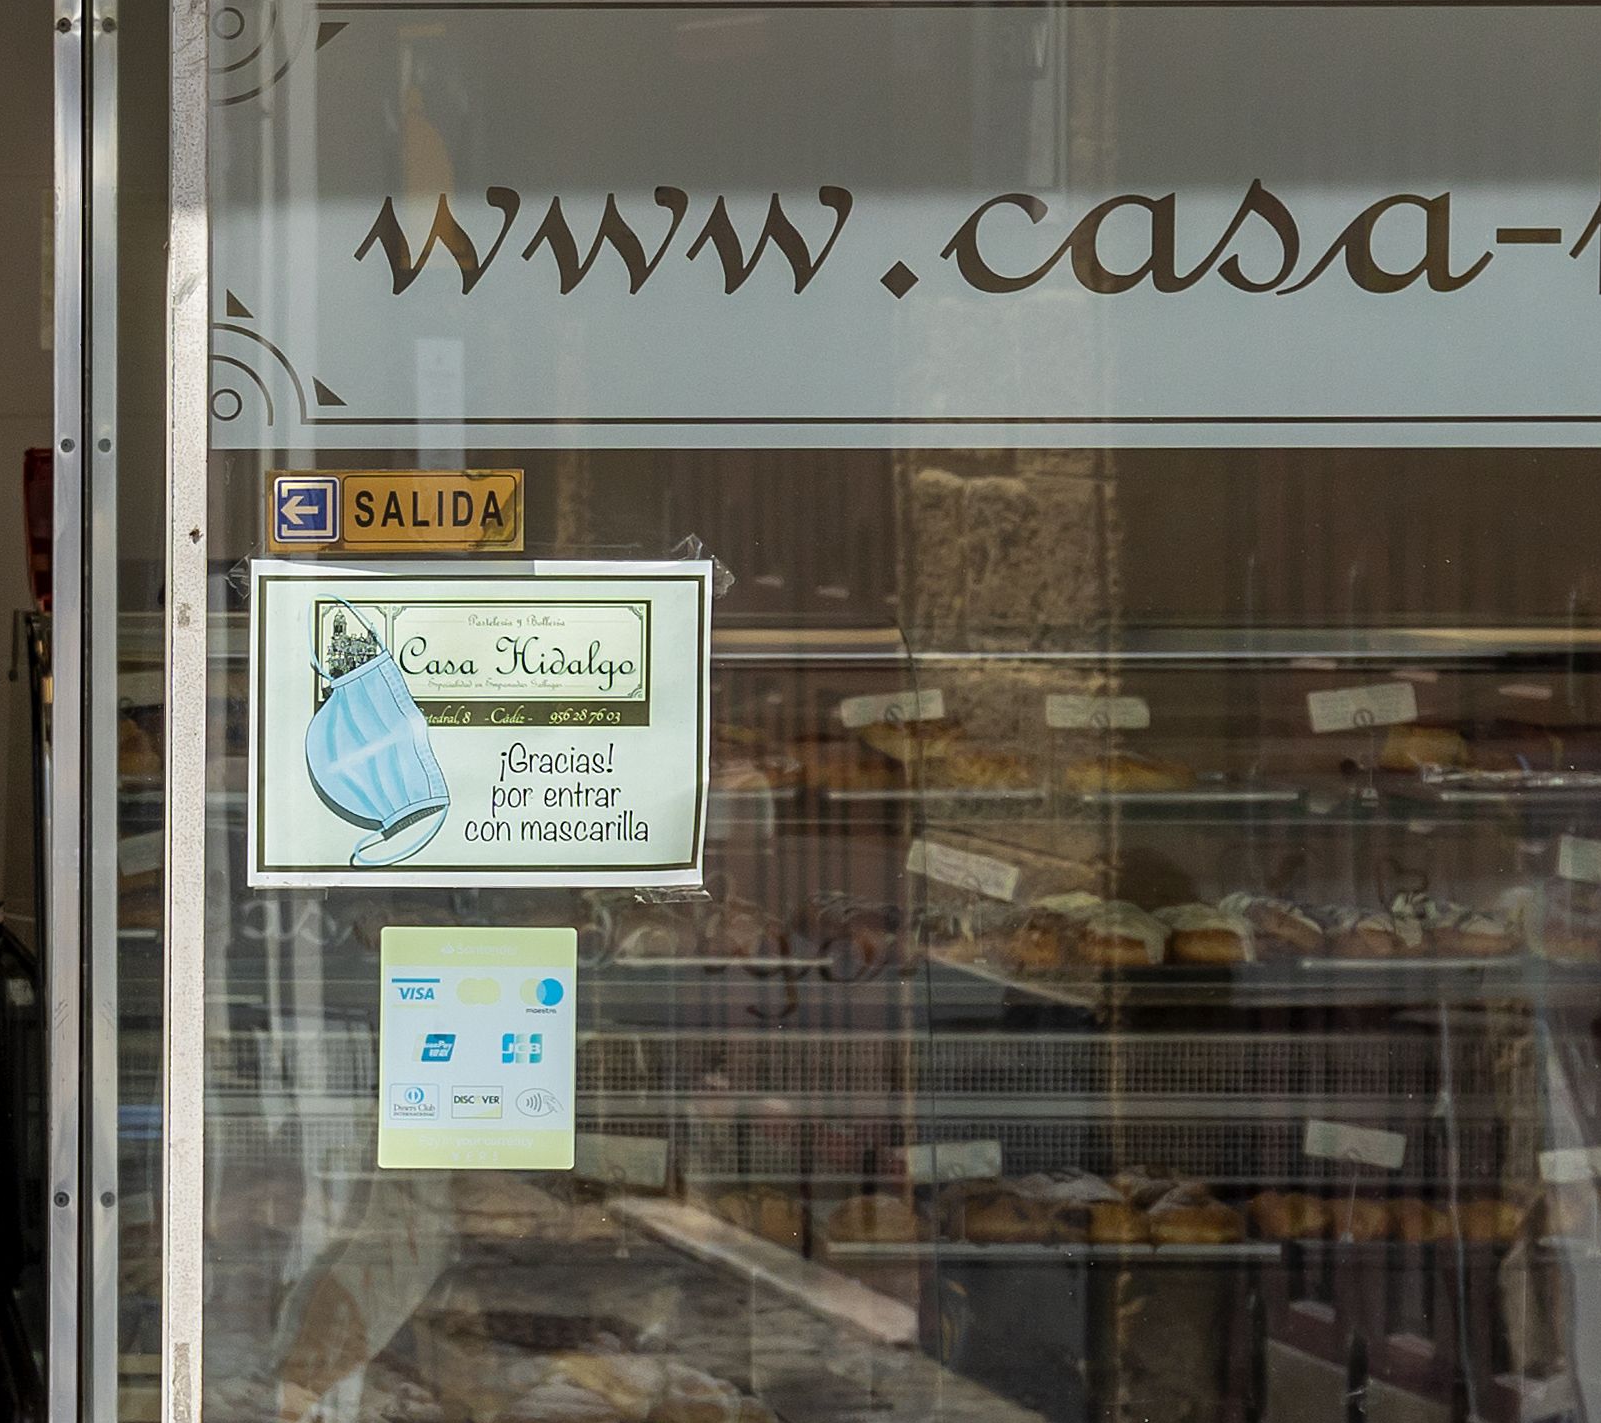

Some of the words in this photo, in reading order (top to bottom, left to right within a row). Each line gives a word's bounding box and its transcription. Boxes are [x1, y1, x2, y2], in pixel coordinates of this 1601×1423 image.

[353, 490, 505, 529] SALIDA
[399, 636, 478, 675] Casa
[495, 636, 636, 691] Hidalgo
[462, 711, 472, 723] 8
[549, 709, 572, 725] 956
[573, 708, 588, 722] 28
[589, 709, 607, 725] 76
[606, 712, 621, 724] 03
[499, 742, 615, 780] ¡Gracias!
[492, 785, 534, 818] por
[543, 781, 621, 809] entrar
[464, 820, 511, 843] con
[520, 810, 649, 843] mascarilla
[397, 986, 435, 1001] VISA
